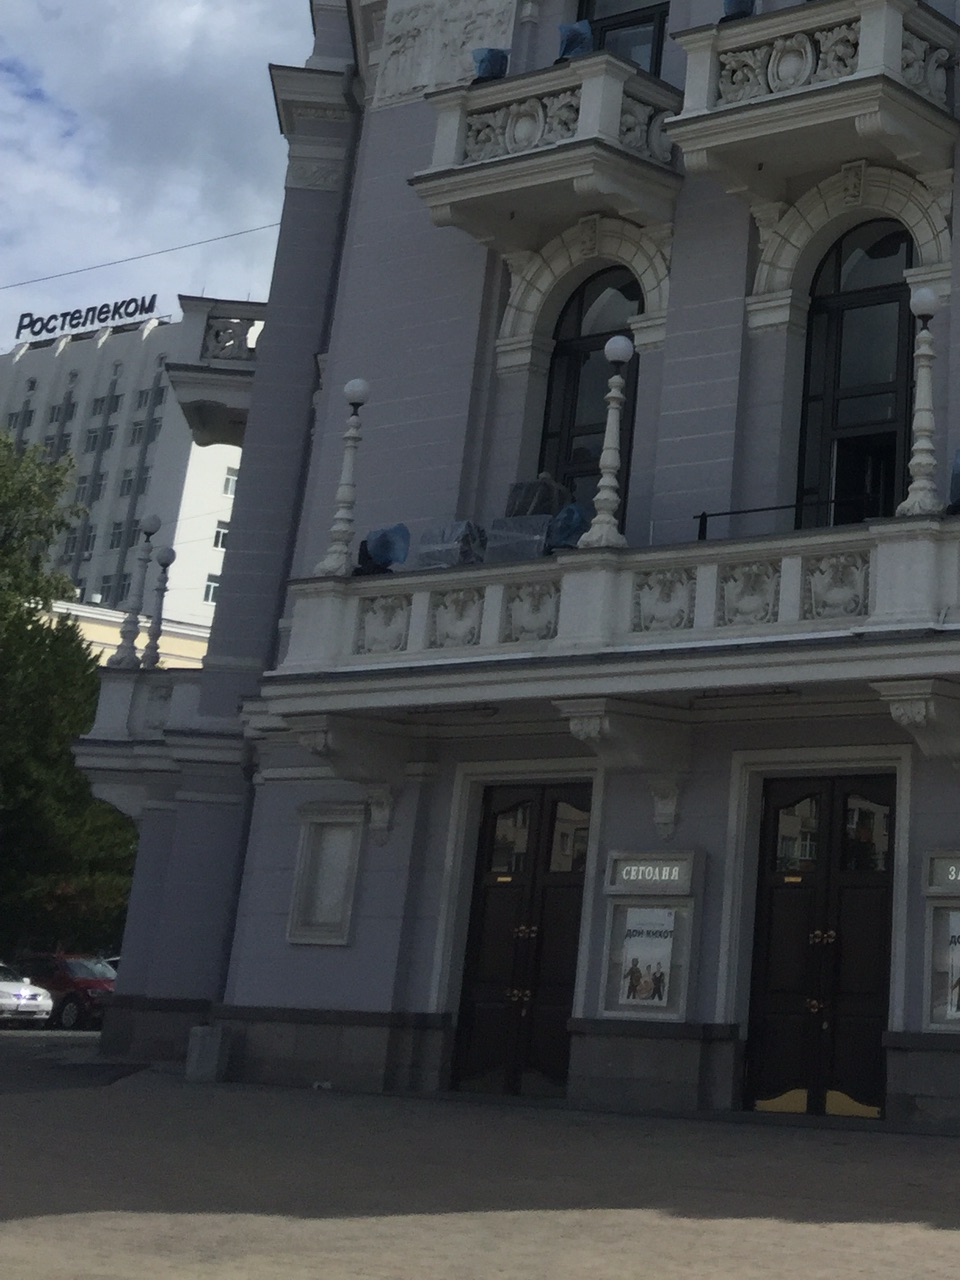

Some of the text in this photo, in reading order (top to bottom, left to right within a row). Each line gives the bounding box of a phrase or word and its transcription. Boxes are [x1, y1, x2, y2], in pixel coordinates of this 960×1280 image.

[15, 294, 157, 339] Ростелеком
[622, 866, 679, 881] СЕГОДНЯ
[625, 928, 674, 939] ДОН КИХОТ
